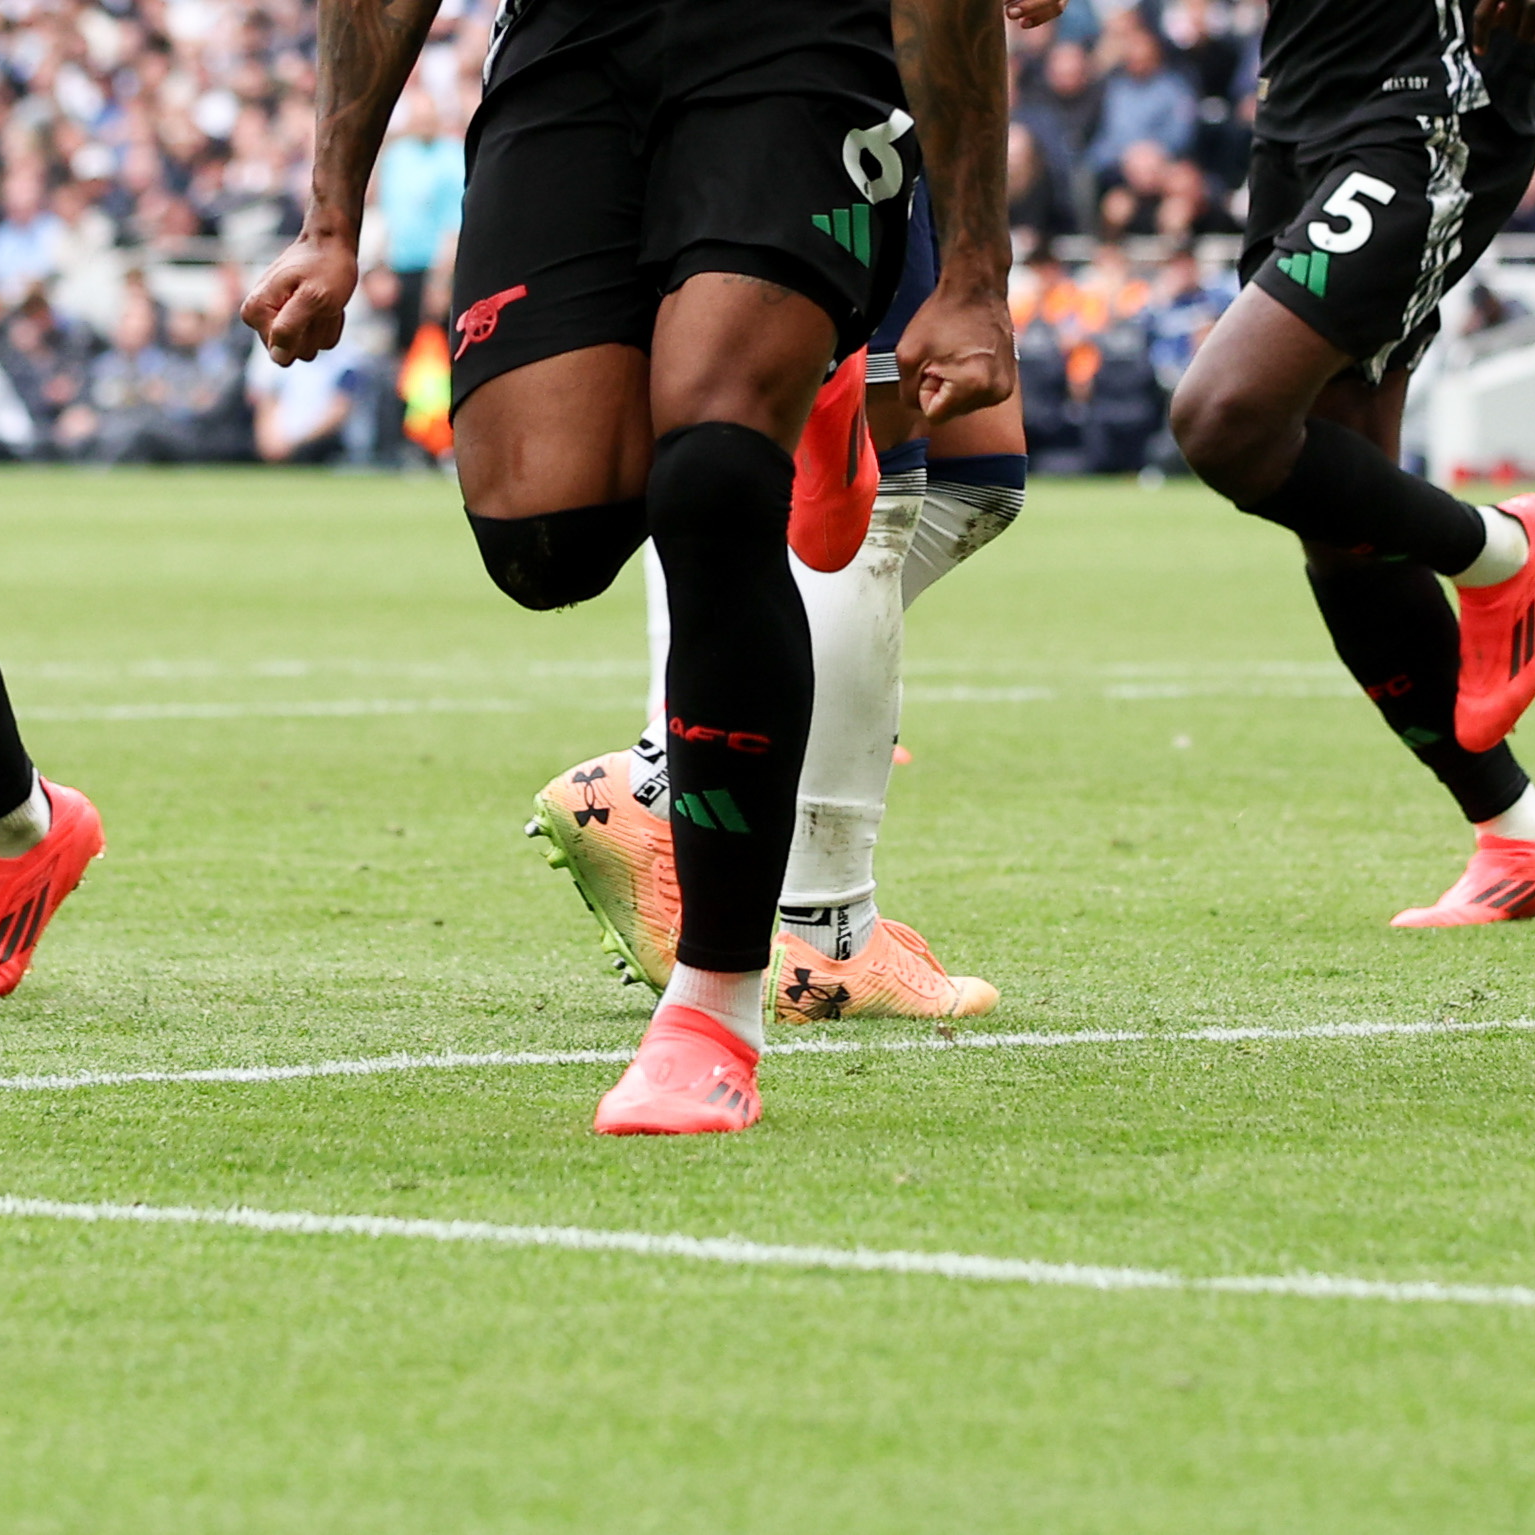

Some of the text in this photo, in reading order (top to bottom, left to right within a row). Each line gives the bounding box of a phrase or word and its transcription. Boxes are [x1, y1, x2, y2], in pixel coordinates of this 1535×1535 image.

[841, 107, 915, 206] 6
[1307, 171, 1397, 254] 5
[669, 716, 773, 755] AFC
